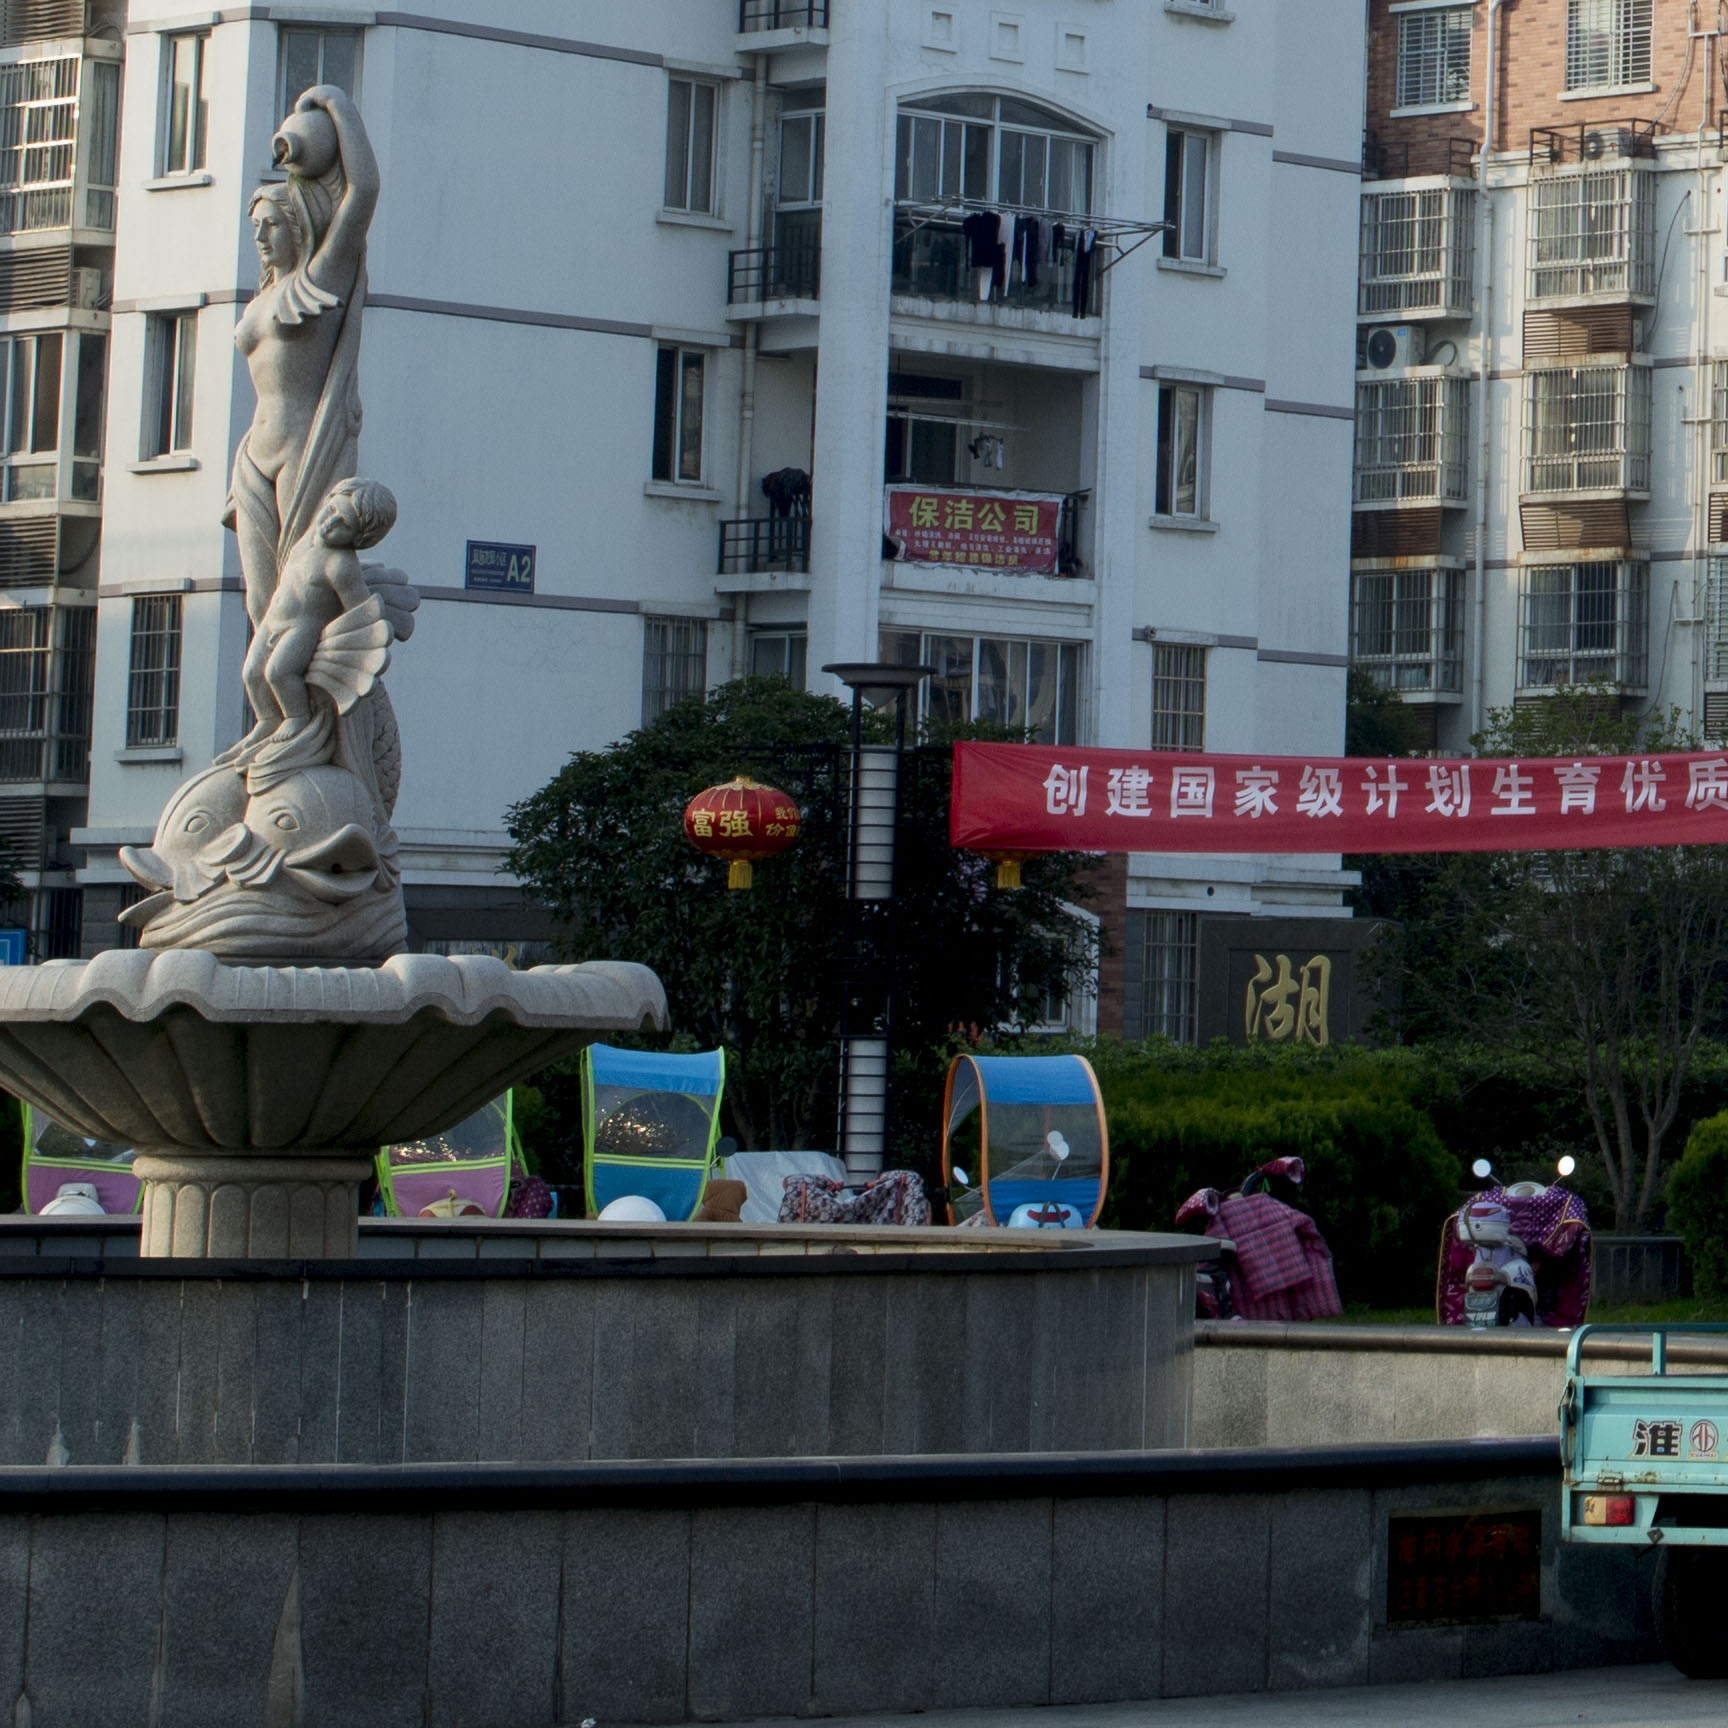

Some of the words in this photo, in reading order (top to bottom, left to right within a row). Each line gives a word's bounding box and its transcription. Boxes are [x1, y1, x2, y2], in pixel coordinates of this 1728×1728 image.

[908, 495, 1039, 535] 保洁公司
[506, 554, 531, 583] A2
[692, 808, 754, 838] 富强
[1634, 1419, 1682, 1458] 淮
